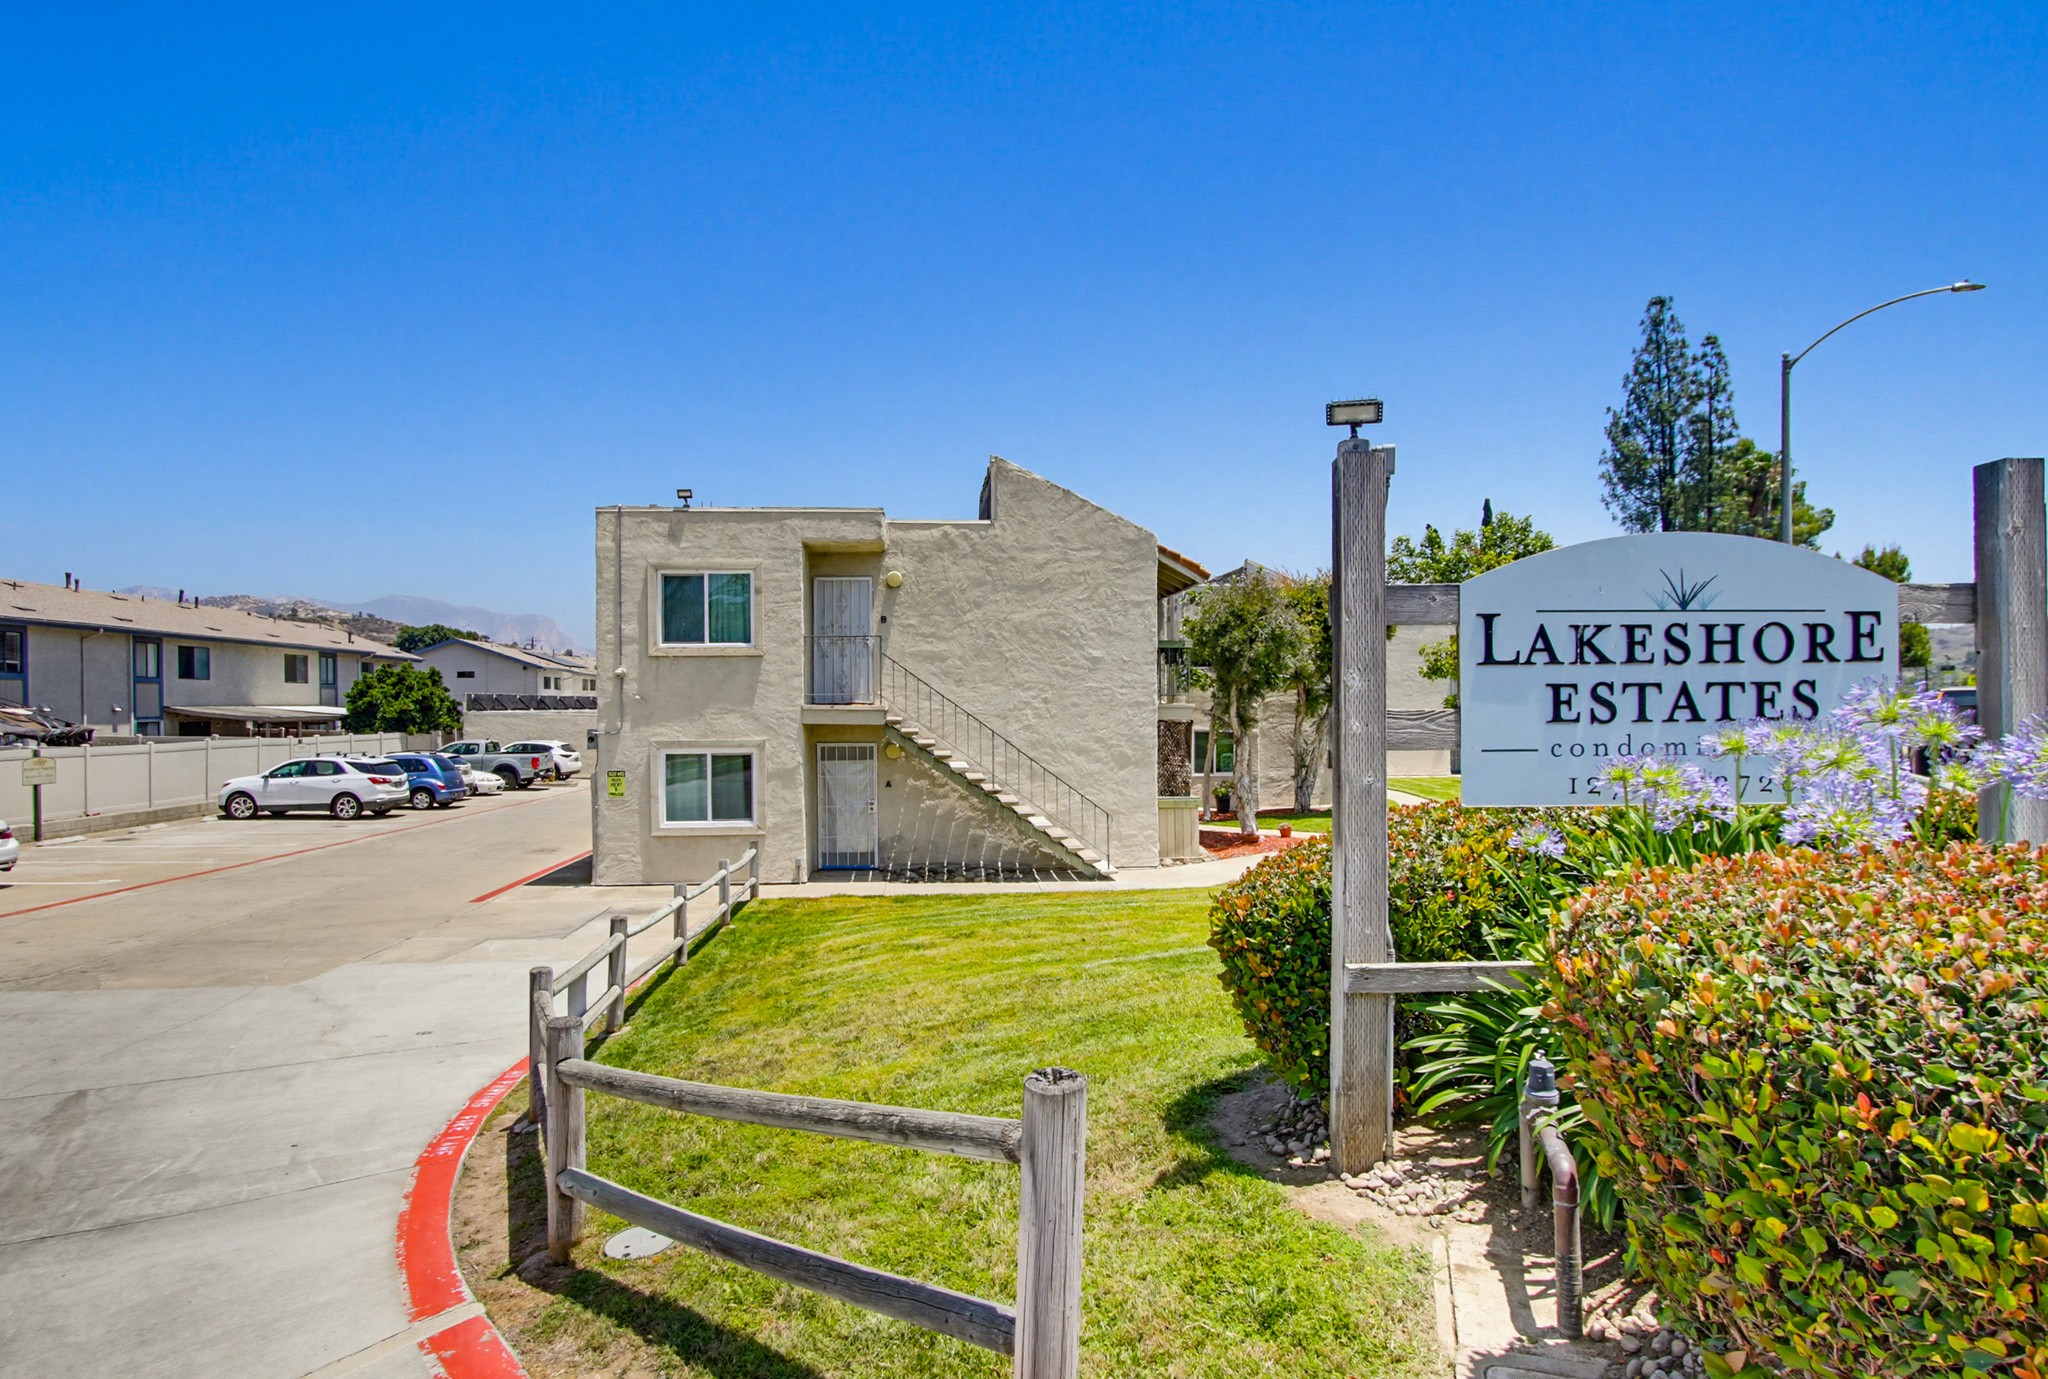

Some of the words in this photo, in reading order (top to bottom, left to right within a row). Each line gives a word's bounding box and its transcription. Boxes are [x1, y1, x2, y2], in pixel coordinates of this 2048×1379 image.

[880, 615, 887, 624] B
[1475, 610, 1885, 666] LAKESHORE
[1545, 679, 1820, 725] ESTATES
[885, 780, 892, 788] A
